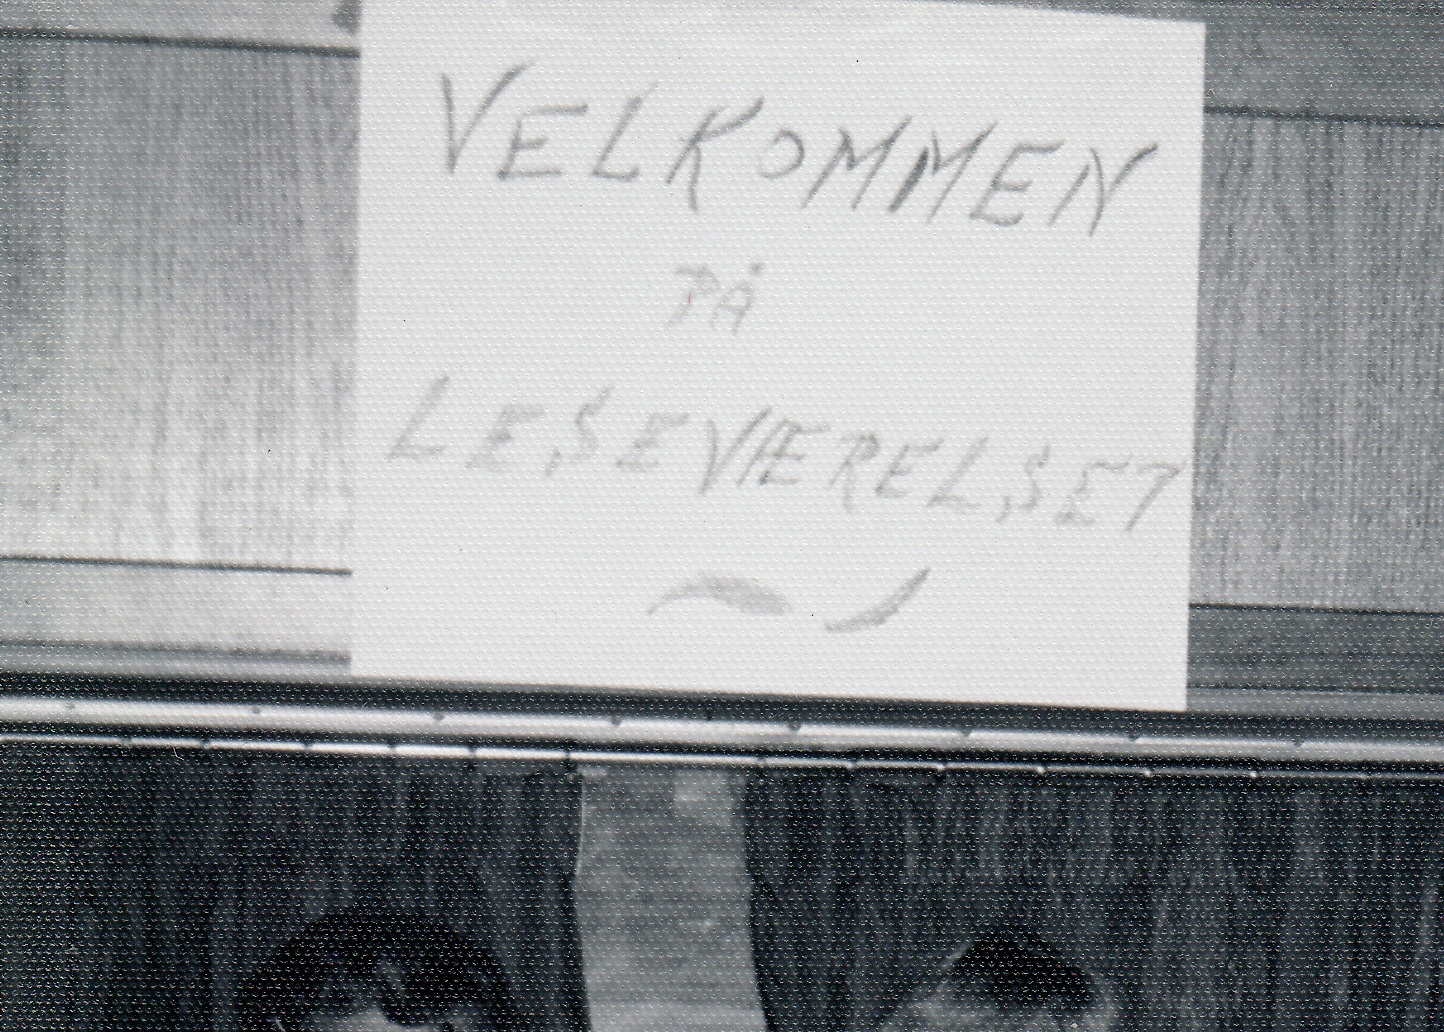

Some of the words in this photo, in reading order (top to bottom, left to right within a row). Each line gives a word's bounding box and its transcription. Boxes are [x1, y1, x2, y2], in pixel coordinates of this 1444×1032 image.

[441, 62, 1159, 237] VELKOMMEN
[669, 262, 766, 334] PÅ
[386, 376, 1184, 531] LESEVÆRELSET
